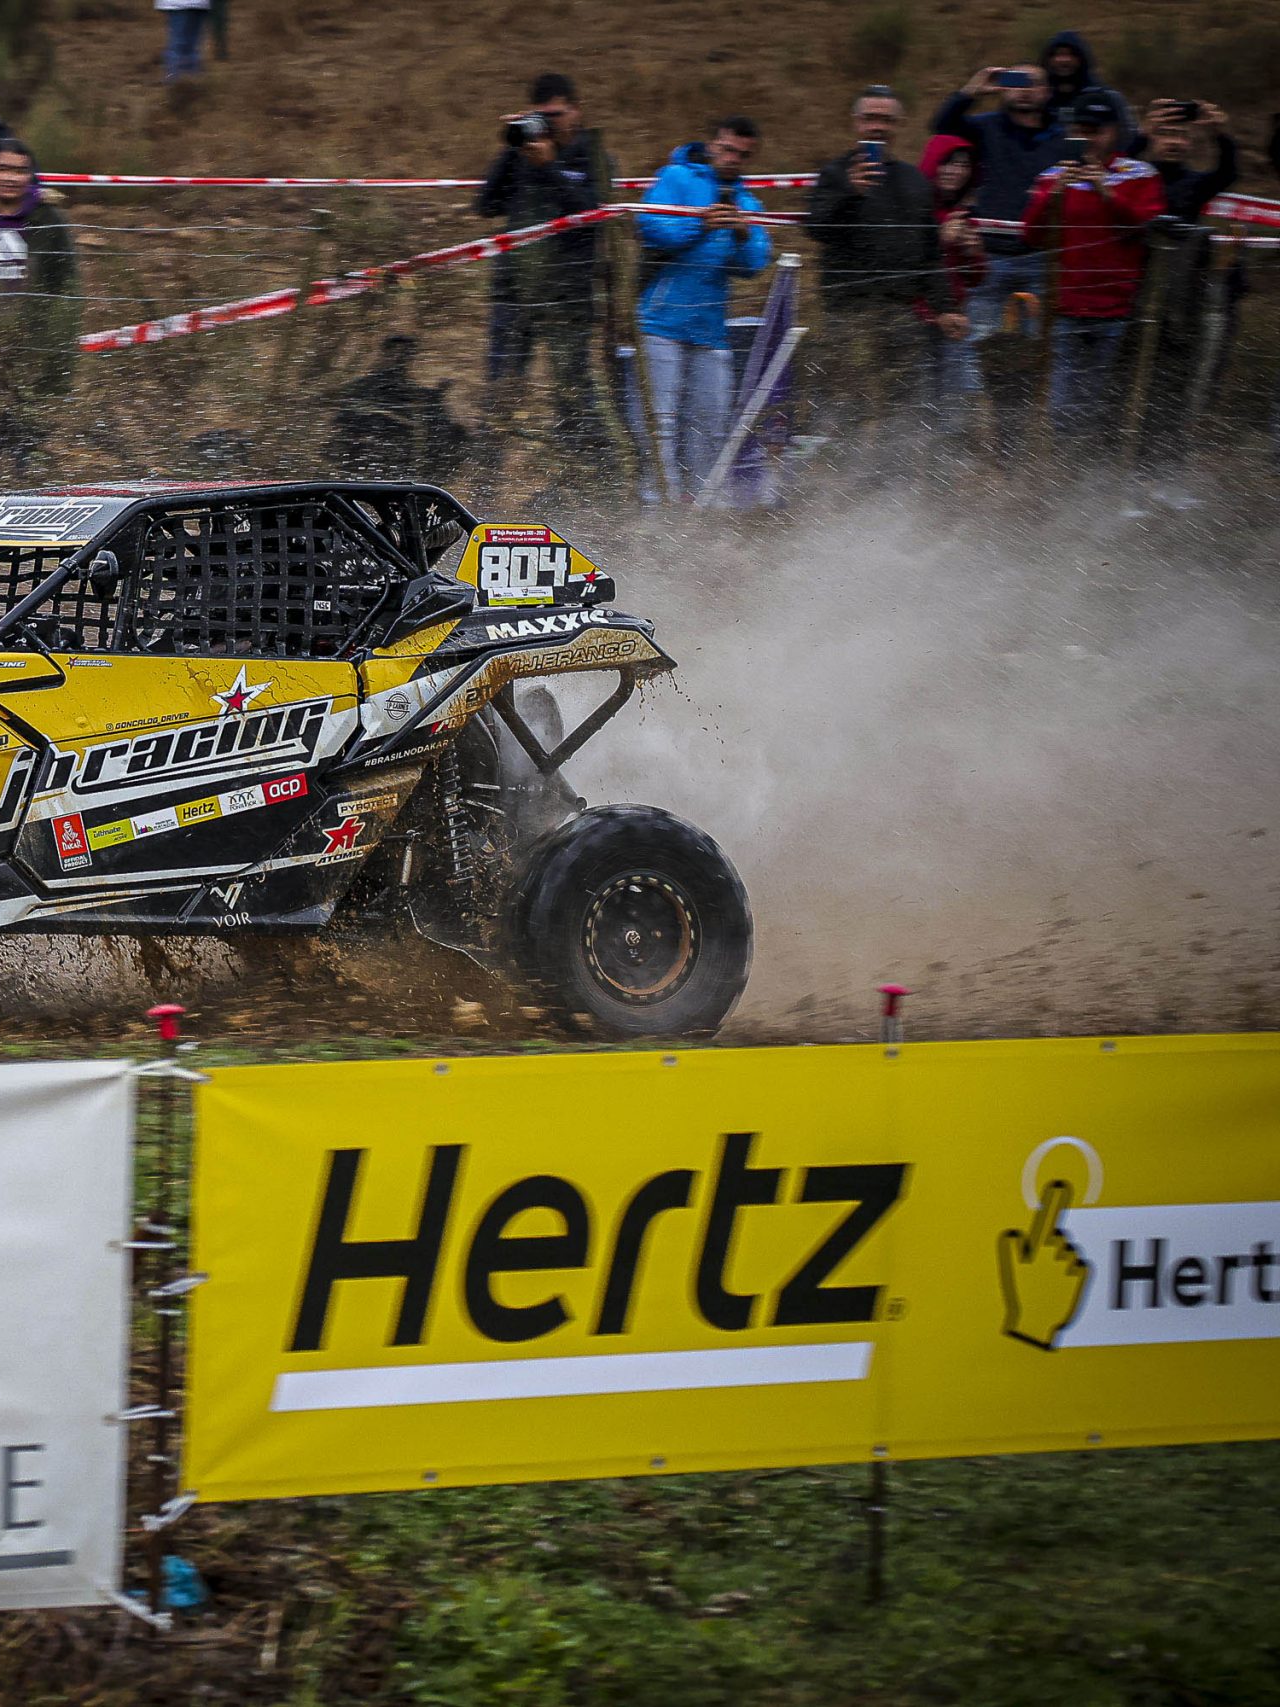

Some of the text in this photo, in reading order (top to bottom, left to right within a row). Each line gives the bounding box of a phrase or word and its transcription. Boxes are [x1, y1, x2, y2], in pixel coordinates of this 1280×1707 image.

[481, 546, 568, 590] 804
[364, 738, 449, 768] #BRASILNODAKAR
[269, 778, 301, 797] acp
[183, 802, 215, 819] Hertz
[340, 796, 397, 814] PYROTECT
[319, 849, 364, 866] ATOMIC
[211, 911, 253, 929] VOIR
[283, 1131, 915, 1352] Hertz
